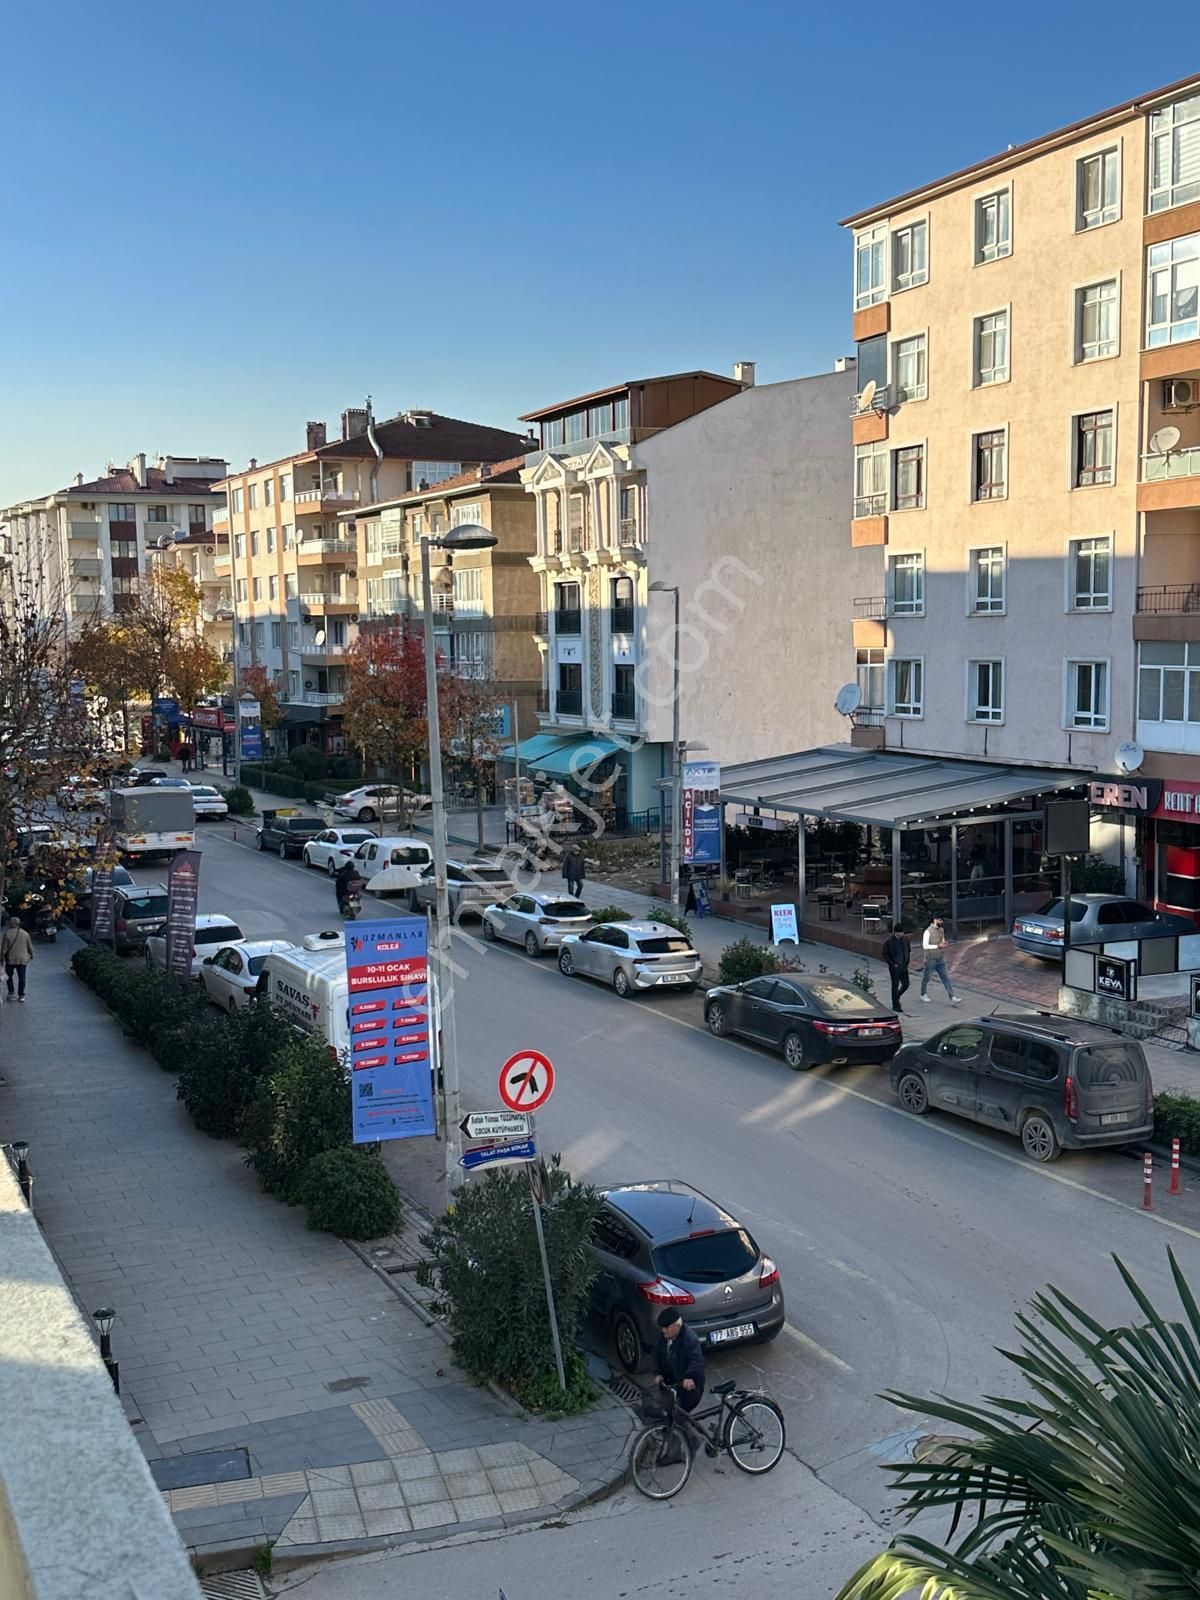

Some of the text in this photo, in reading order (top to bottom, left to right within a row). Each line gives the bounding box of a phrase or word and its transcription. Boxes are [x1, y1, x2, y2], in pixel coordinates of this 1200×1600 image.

[1091, 781, 1147, 810] EREN
[1164, 791, 1194, 812] RENT
[362, 930, 423, 942] UZMANLAR
[367, 963, 410, 973] 10-11 OCAK
[351, 972, 427, 985] BURSLULUK SINAVI
[474, 1127, 491, 1136] ÇOCUK
